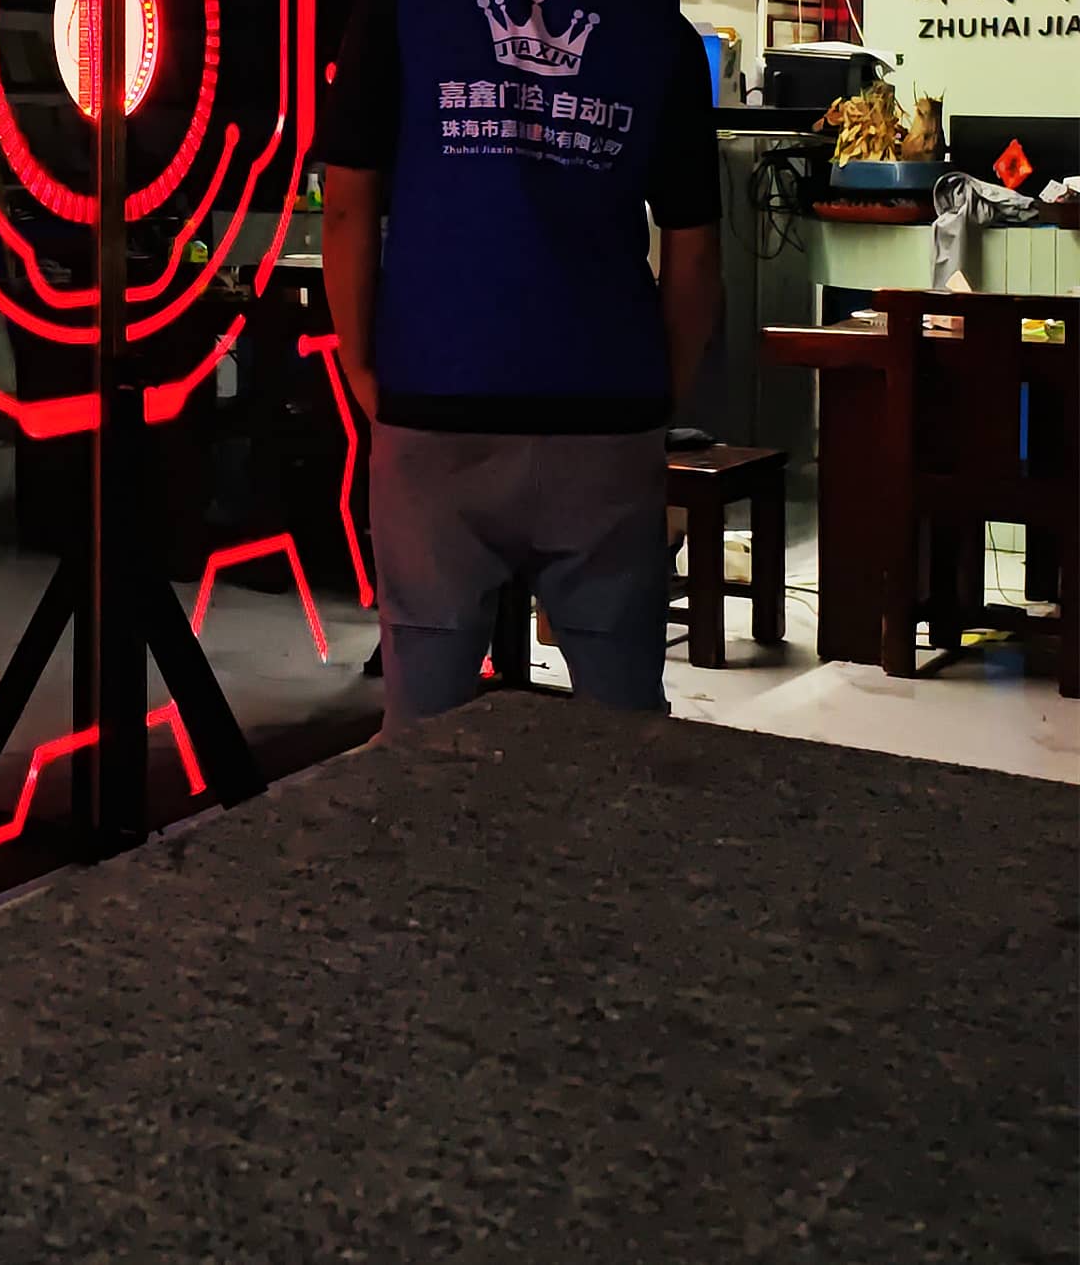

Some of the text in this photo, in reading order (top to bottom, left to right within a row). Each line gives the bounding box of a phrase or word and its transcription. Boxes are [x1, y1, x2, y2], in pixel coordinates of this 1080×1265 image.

[918, 14, 1080, 38] ZHUHAI JIA
[442, 145, 479, 155] Zhuhai
